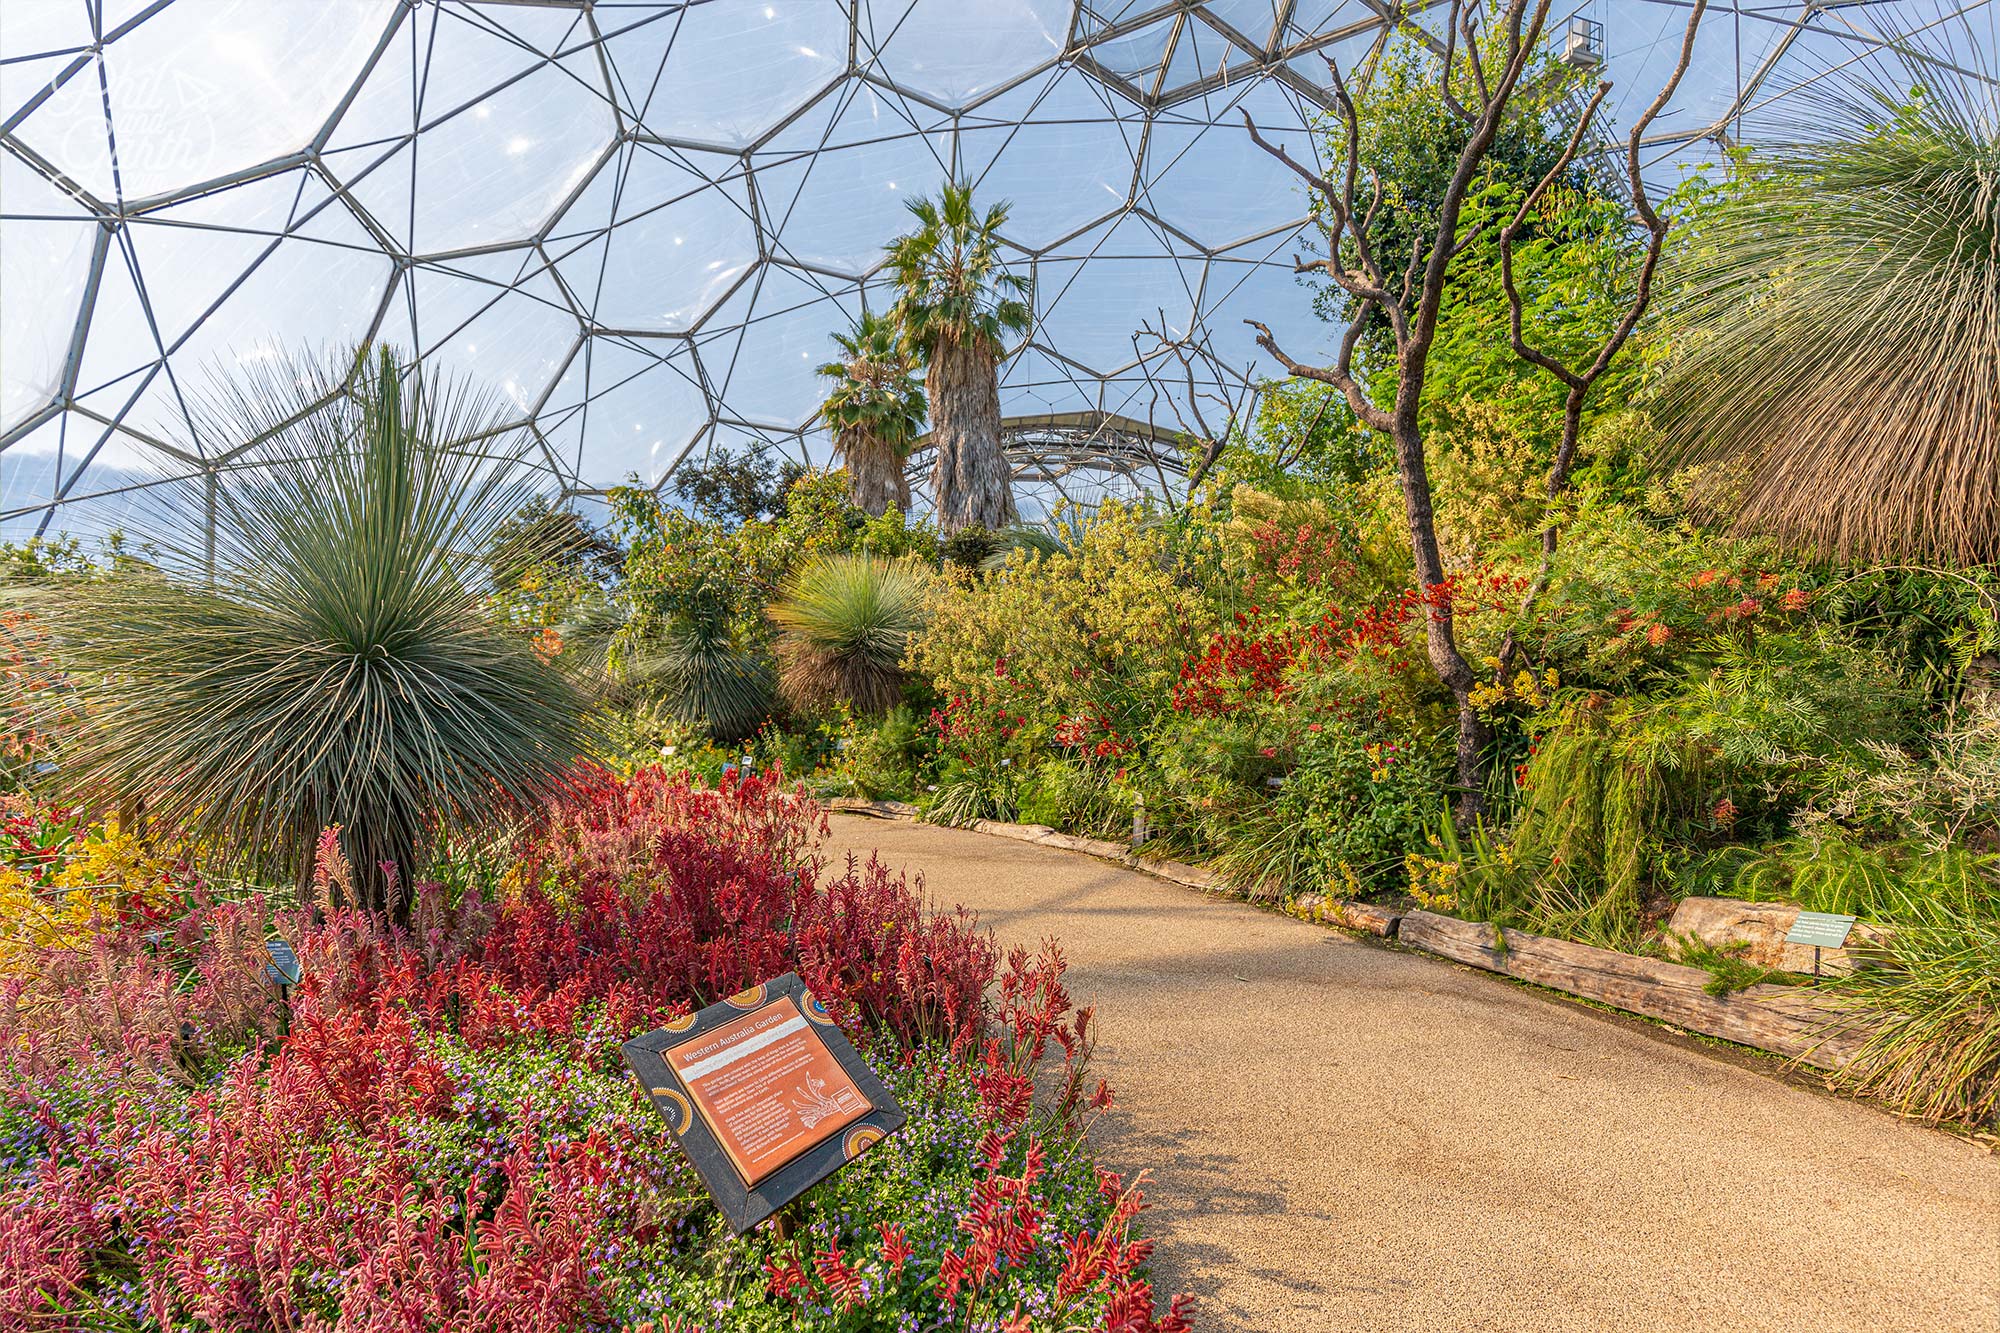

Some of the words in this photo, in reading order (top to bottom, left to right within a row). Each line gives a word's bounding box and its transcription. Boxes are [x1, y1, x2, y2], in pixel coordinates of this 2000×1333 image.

[683, 1041, 719, 1062] Western
[717, 1025, 755, 1046] Australia
[754, 1011, 783, 1029] Garden
